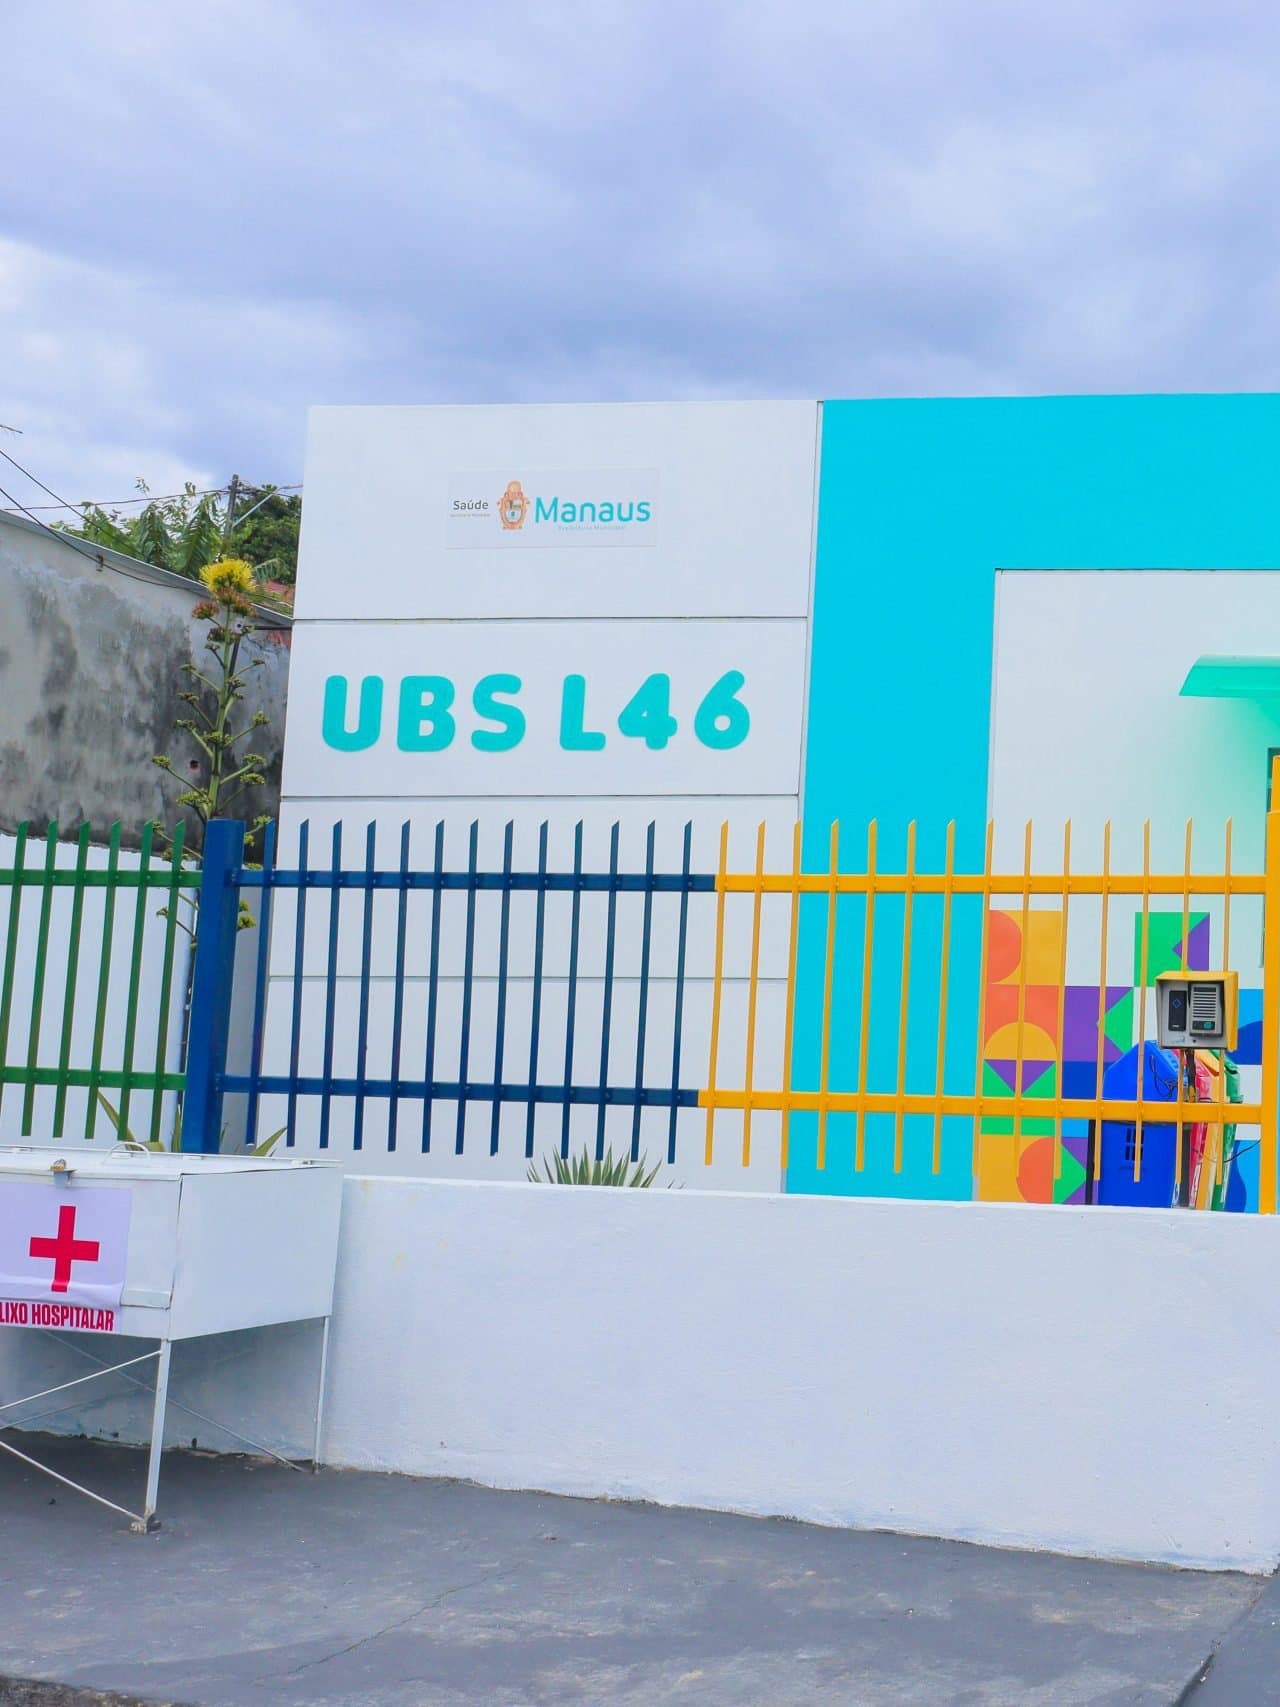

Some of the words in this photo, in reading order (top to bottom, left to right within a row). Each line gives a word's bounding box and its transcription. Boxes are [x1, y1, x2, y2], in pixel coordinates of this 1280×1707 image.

[453, 499, 489, 510] Saúde
[535, 496, 651, 523] Manaus
[322, 673, 526, 752] UBS
[559, 670, 750, 750] L46
[0, 1302, 28, 1325] LIXO
[31, 1303, 115, 1331] HOSPITALAR
